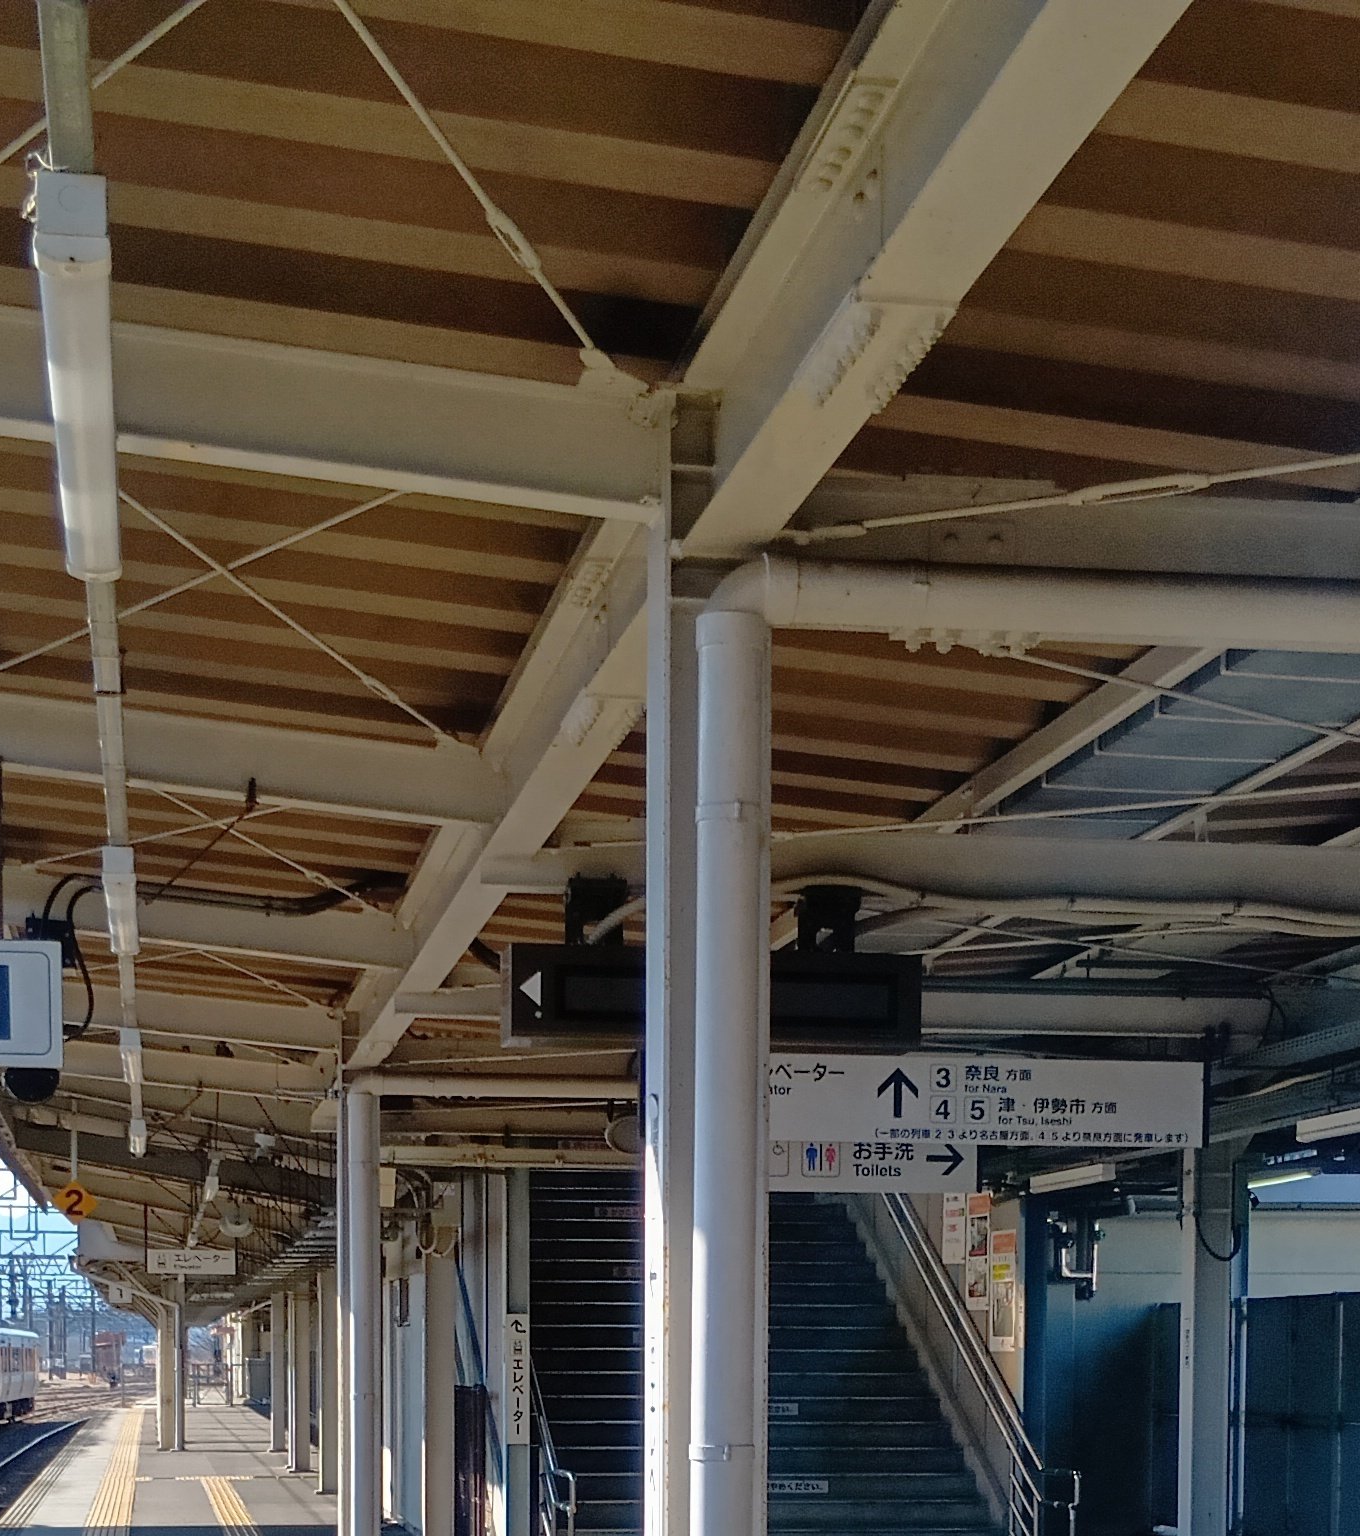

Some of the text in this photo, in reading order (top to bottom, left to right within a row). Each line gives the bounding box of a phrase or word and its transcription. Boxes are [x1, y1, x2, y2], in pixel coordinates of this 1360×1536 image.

[936, 1067, 951, 1089] 3
[965, 1084, 1008, 1094] for Nara
[935, 1099, 951, 1120] 4
[970, 1099, 985, 1121] 5
[998, 1115, 1013, 1125] for
[852, 1142, 915, 1161] お手洗
[852, 1163, 902, 1177] Toilets
[66, 1188, 84, 1217] 2
[512, 1359, 525, 1435] エレベーター
[767, 1481, 824, 1492] やめください。
